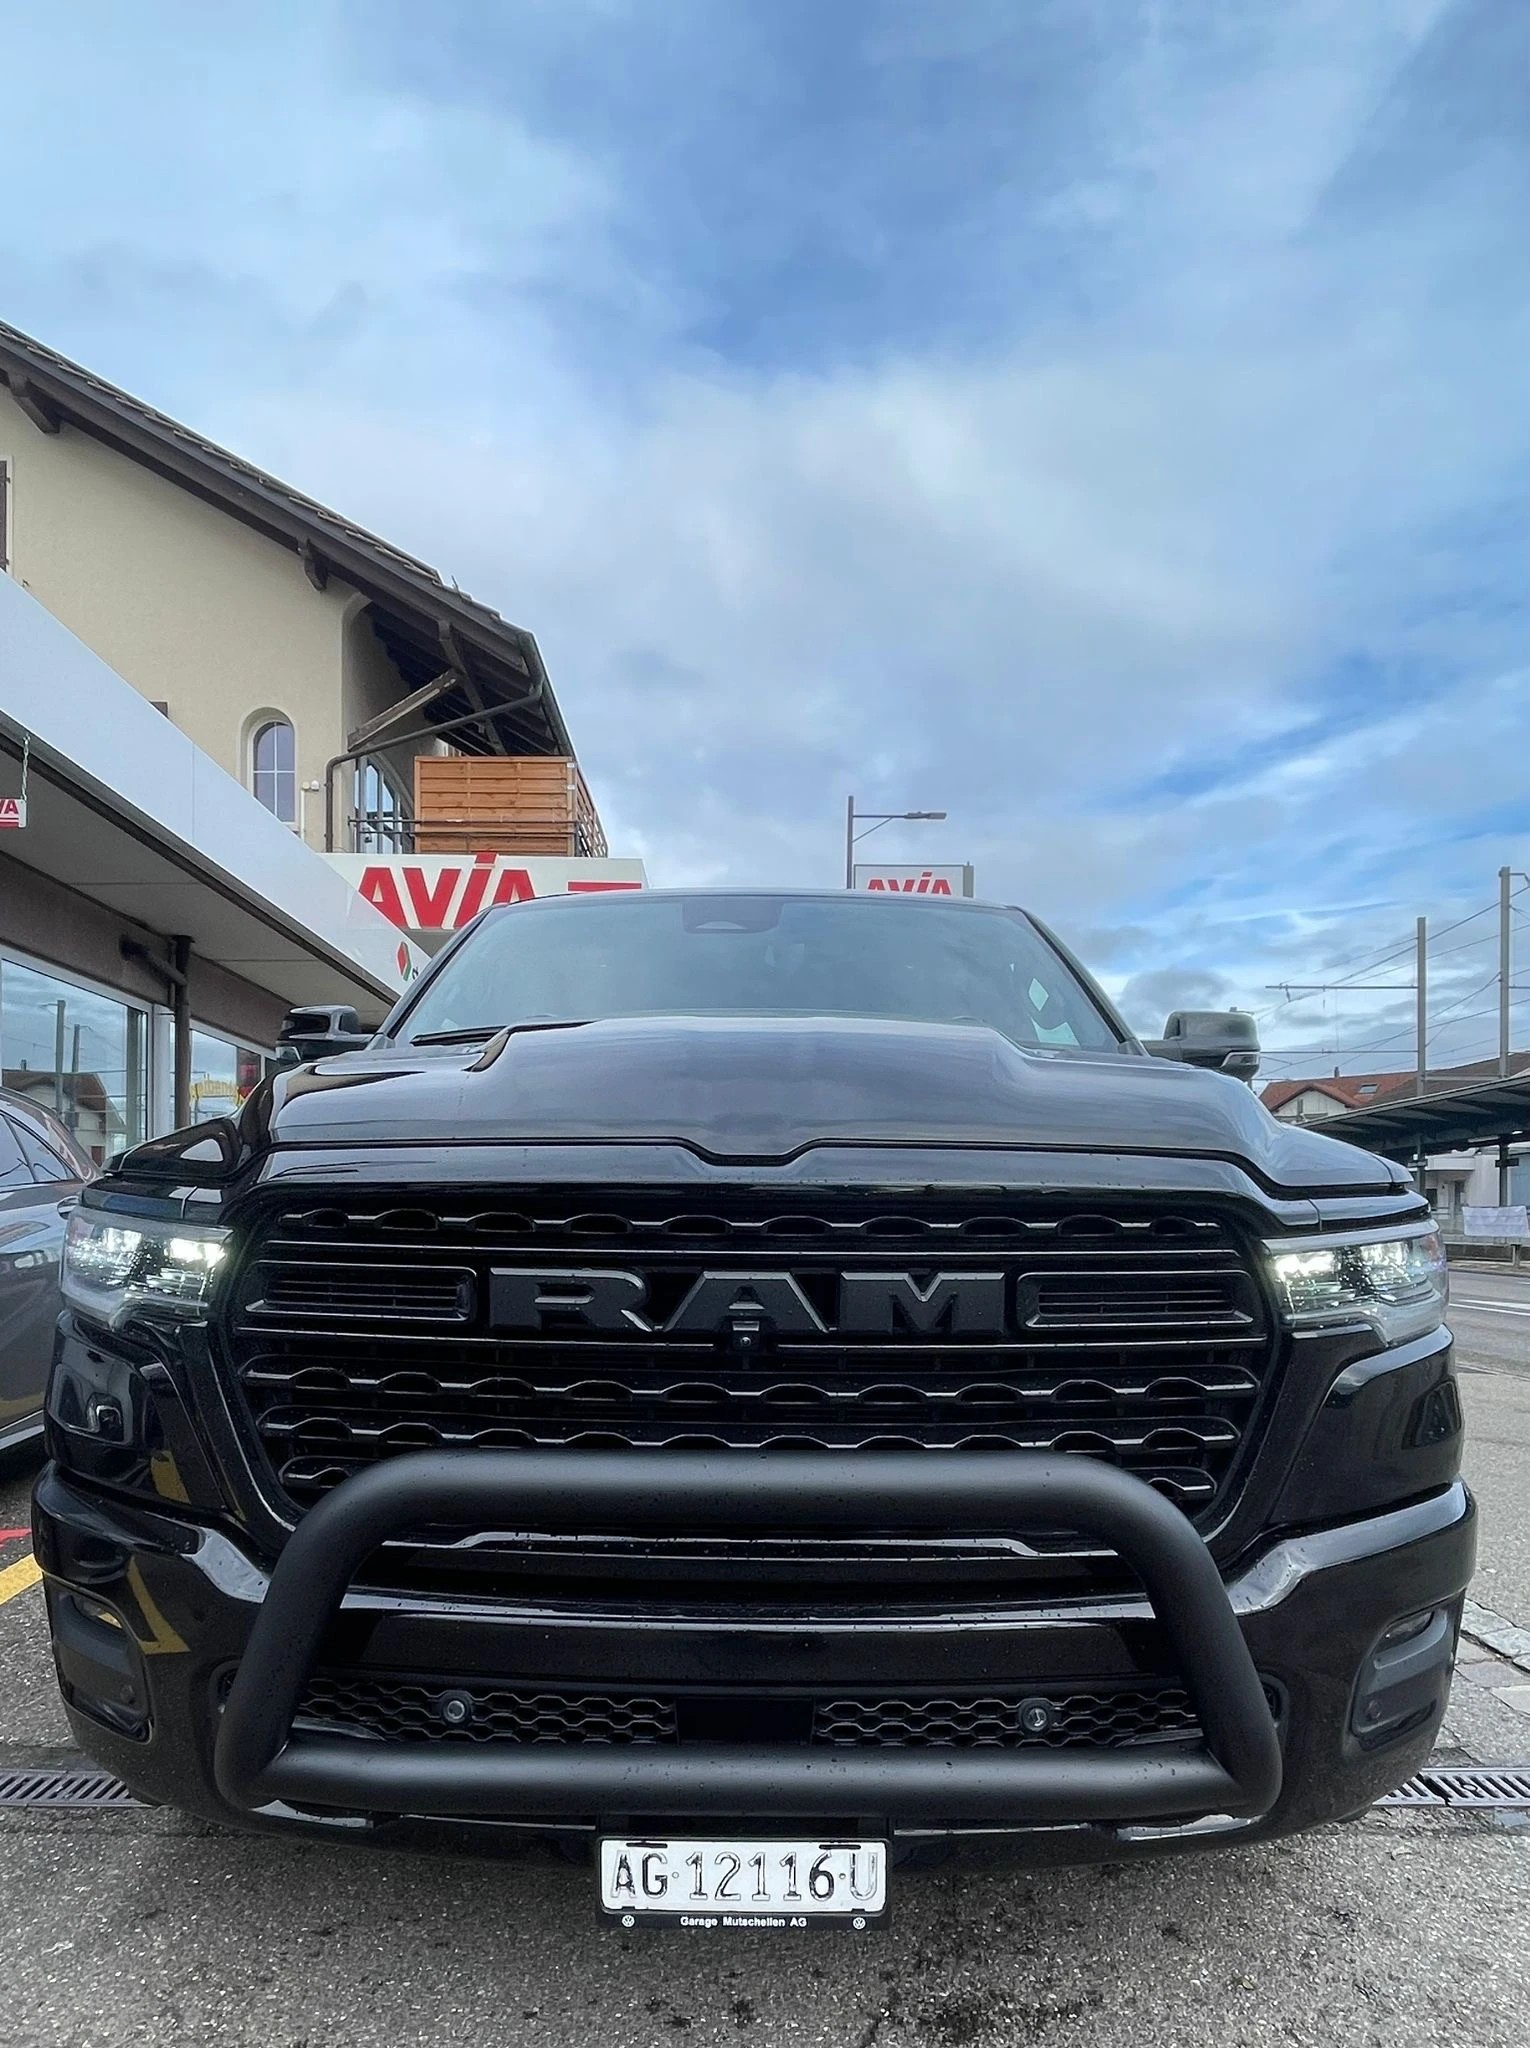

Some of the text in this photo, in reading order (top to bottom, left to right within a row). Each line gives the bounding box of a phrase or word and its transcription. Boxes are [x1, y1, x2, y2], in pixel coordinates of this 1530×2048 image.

[488, 1266, 1005, 1334] RAM
[680, 1916, 718, 1928] Garage
[790, 1917, 808, 1927] AG
